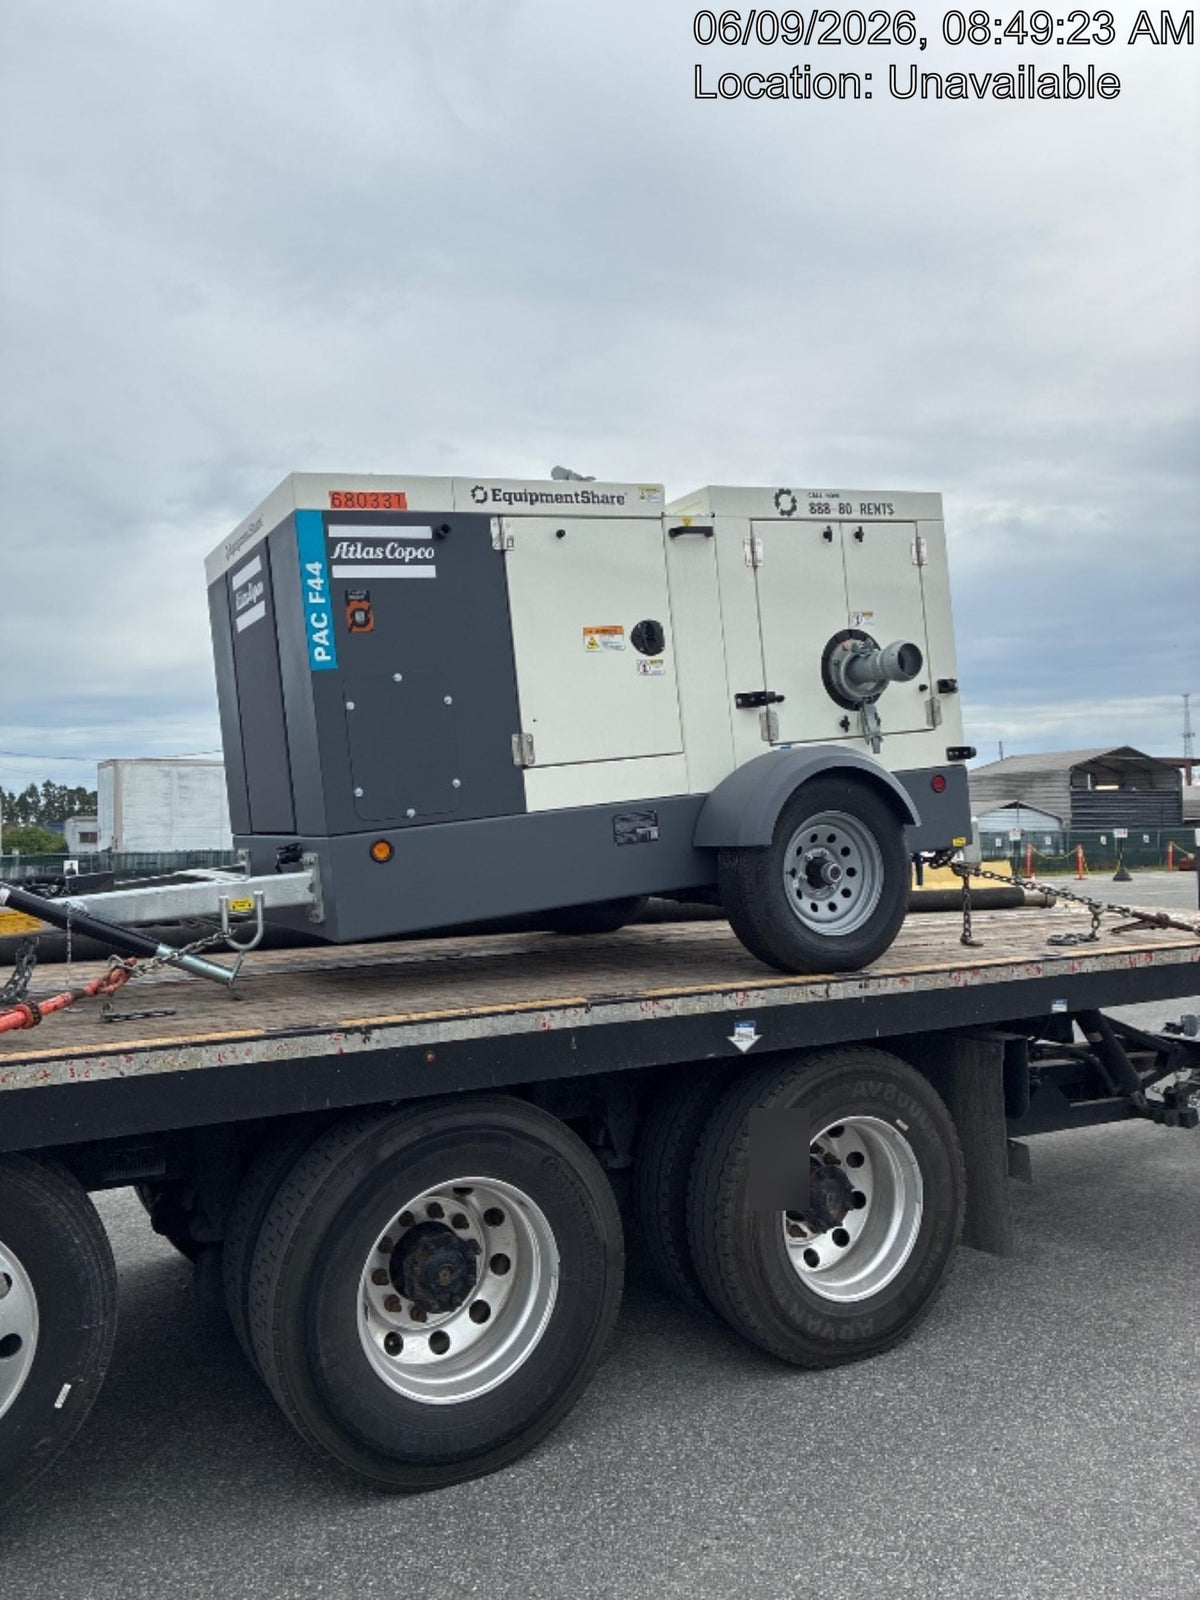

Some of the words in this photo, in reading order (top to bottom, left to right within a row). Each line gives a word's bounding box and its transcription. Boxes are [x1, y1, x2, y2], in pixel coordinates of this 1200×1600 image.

[331, 492, 402, 508] 680331
[491, 488, 626, 506] EquipmentShare
[305, 561, 326, 604] F44
[310, 612, 332, 663] PAC
